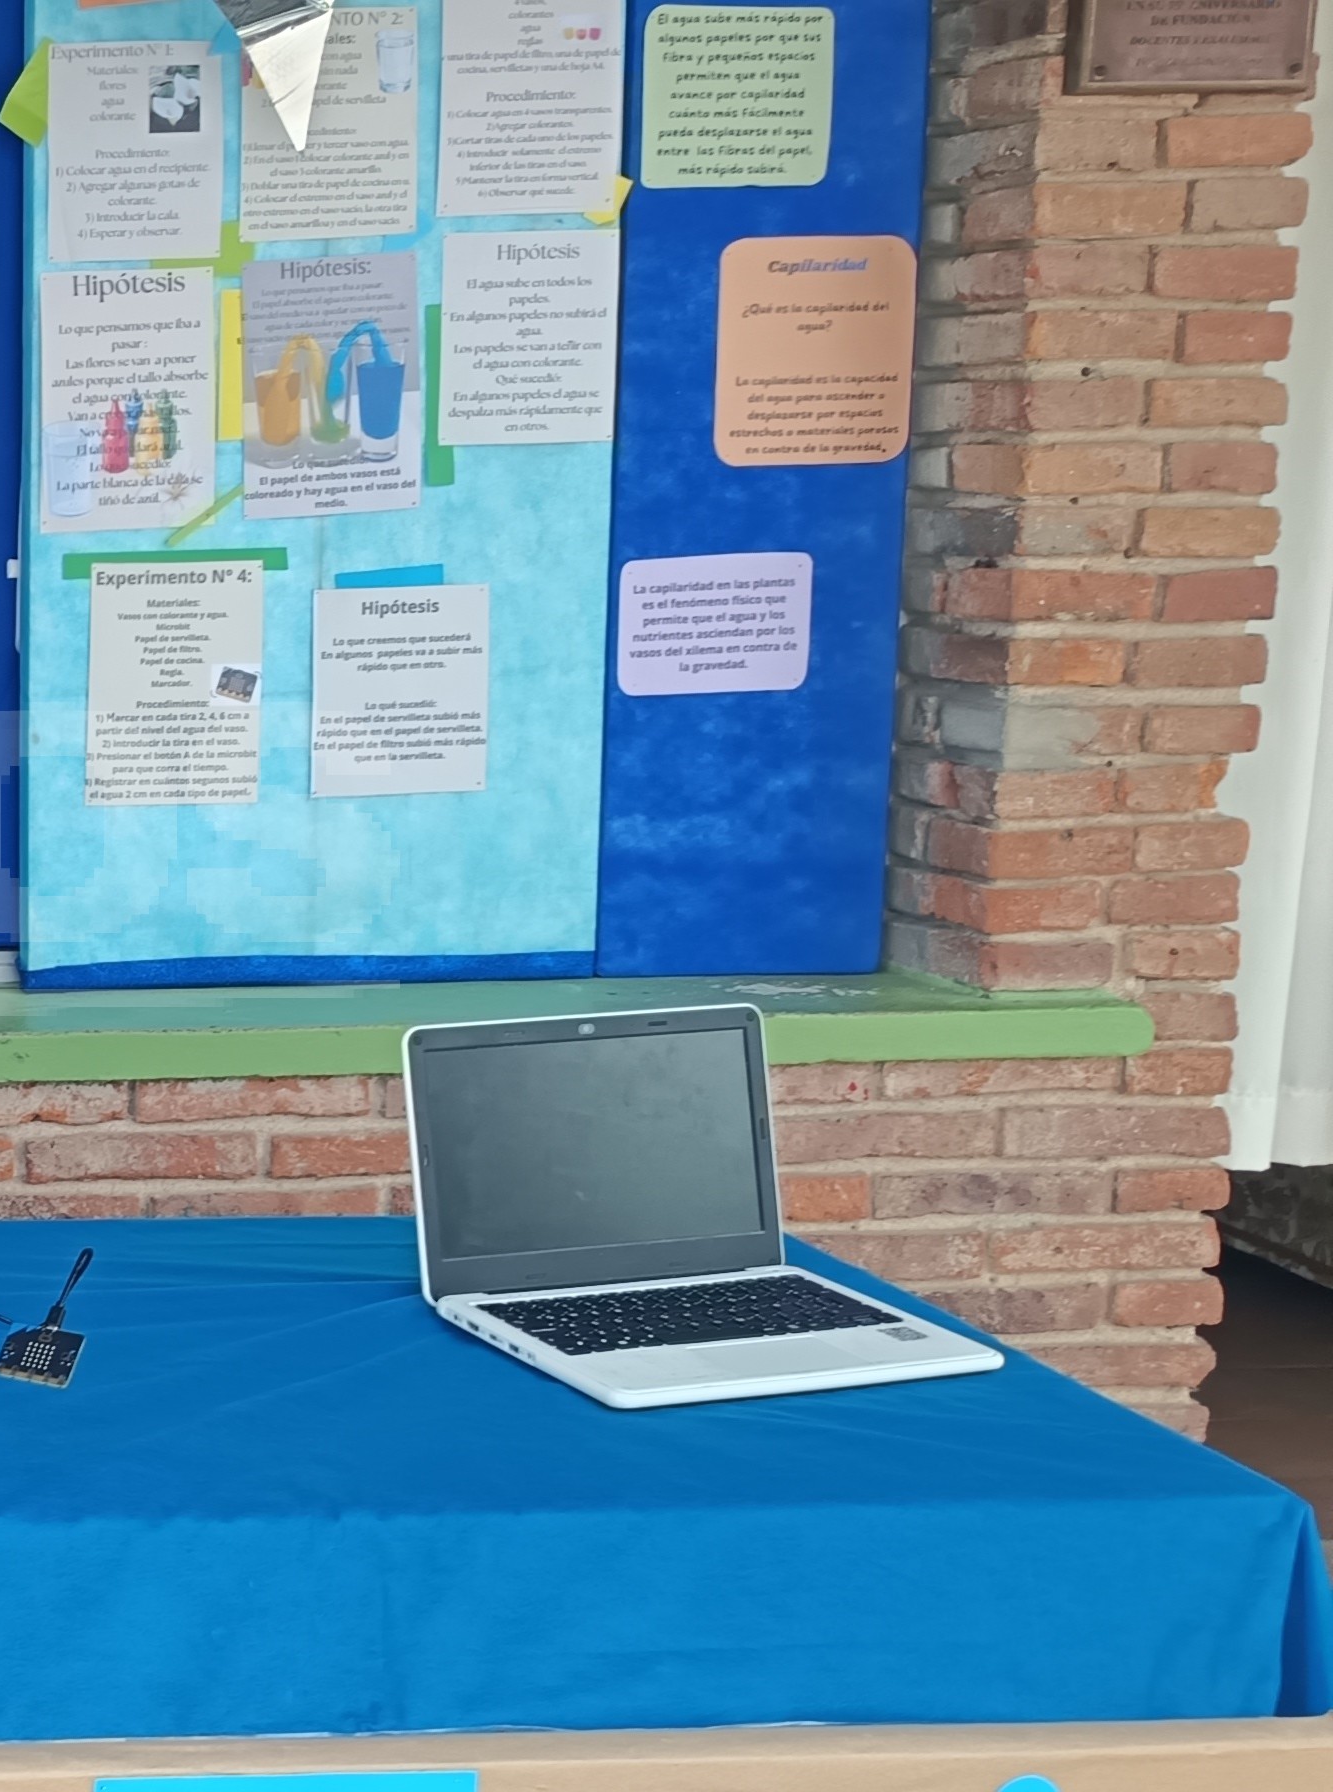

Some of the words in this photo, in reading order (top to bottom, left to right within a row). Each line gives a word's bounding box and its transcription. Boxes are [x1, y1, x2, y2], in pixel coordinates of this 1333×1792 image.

[497, 243, 580, 265] Hipótesis
[280, 259, 371, 283] Hipótesis:
[768, 258, 868, 275] Capilaridad
[72, 273, 186, 302] Hipótesis
[260, 475, 268, 485] El
[271, 473, 298, 488] papel
[300, 472, 313, 482] de
[315, 470, 348, 481] ambos
[350, 470, 377, 478] vasos
[380, 466, 401, 476] está
[96, 570, 207, 589] Experimento
[237, 569, 252, 583] 4:
[633, 584, 646, 594] La
[649, 581, 713, 595] capilaridad
[717, 582, 731, 590] en
[734, 579, 750, 589] las
[753, 577, 795, 590] plantas
[361, 599, 440, 618] Hipótesis
[642, 602, 654, 610] es
[657, 599, 667, 609] el
[671, 597, 729, 608] fenómeno
[732, 595, 762, 605] físico
[765, 596, 786, 606] que
[643, 614, 688, 627] permite
[692, 614, 712, 625] que
[716, 612, 726, 622] el
[729, 613, 756, 623] agua
[759, 612, 766, 622] y
[769, 609, 785, 620] los
[633, 630, 693, 642] nutrientes
[696, 628, 753, 639] asciendan
[756, 628, 776, 639] por
[779, 625, 795, 636] los
[630, 649, 662, 658] vasos
[665, 646, 682, 656] del
[685, 645, 723, 655] xilema
[726, 645, 740, 654] en
[743, 642, 780, 653] contra
[784, 641, 797, 651] de
[679, 661, 690, 671] la
[692, 659, 748, 673] gravedad.
